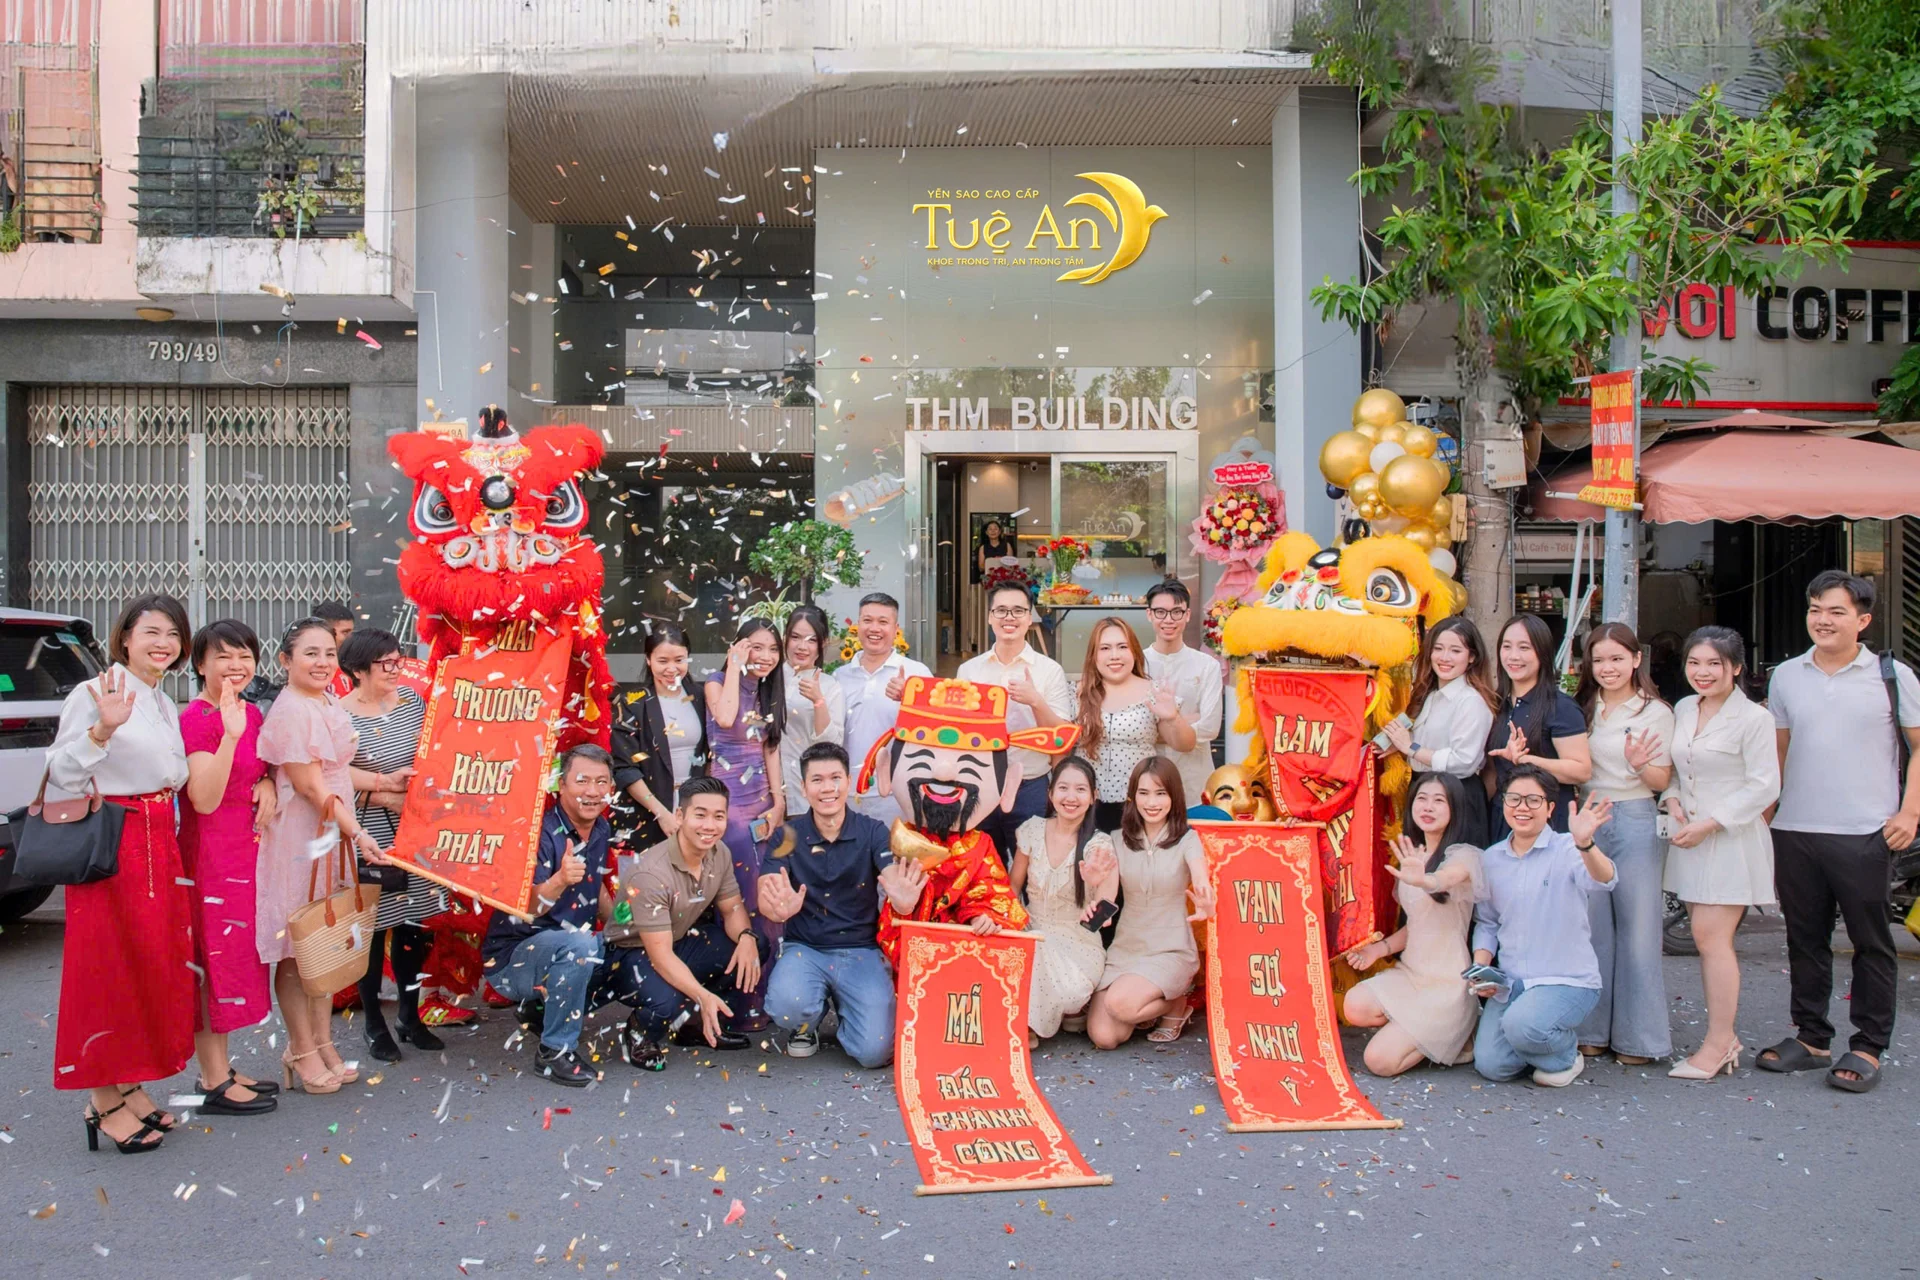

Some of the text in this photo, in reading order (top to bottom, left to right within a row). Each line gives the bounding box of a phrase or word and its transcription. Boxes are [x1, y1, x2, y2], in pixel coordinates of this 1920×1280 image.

[955, 189, 980, 199] SAO
[985, 189, 1011, 199] CAO
[1015, 187, 1040, 199] CẤP
[912, 203, 1102, 254] Tuệ An
[956, 257, 990, 266] TRONG
[1012, 257, 1026, 266] AN
[1028, 257, 1062, 266] TRONG
[1064, 255, 1085, 266] TÂM
[148, 341, 218, 363] 793/49
[905, 396, 1198, 431] THM BUILDING
[1273, 714, 1334, 758] LÀM
[449, 751, 515, 796] HỒNG
[430, 829, 505, 866] PHÁT
[1233, 880, 1285, 934] VẠN
[1249, 948, 1284, 1008] SỰ
[944, 983, 985, 1046] MÃ
[1246, 1021, 1306, 1064] NHƯ
[937, 1066, 1000, 1101] ĐÁO
[954, 1138, 1043, 1165] CÔNG
